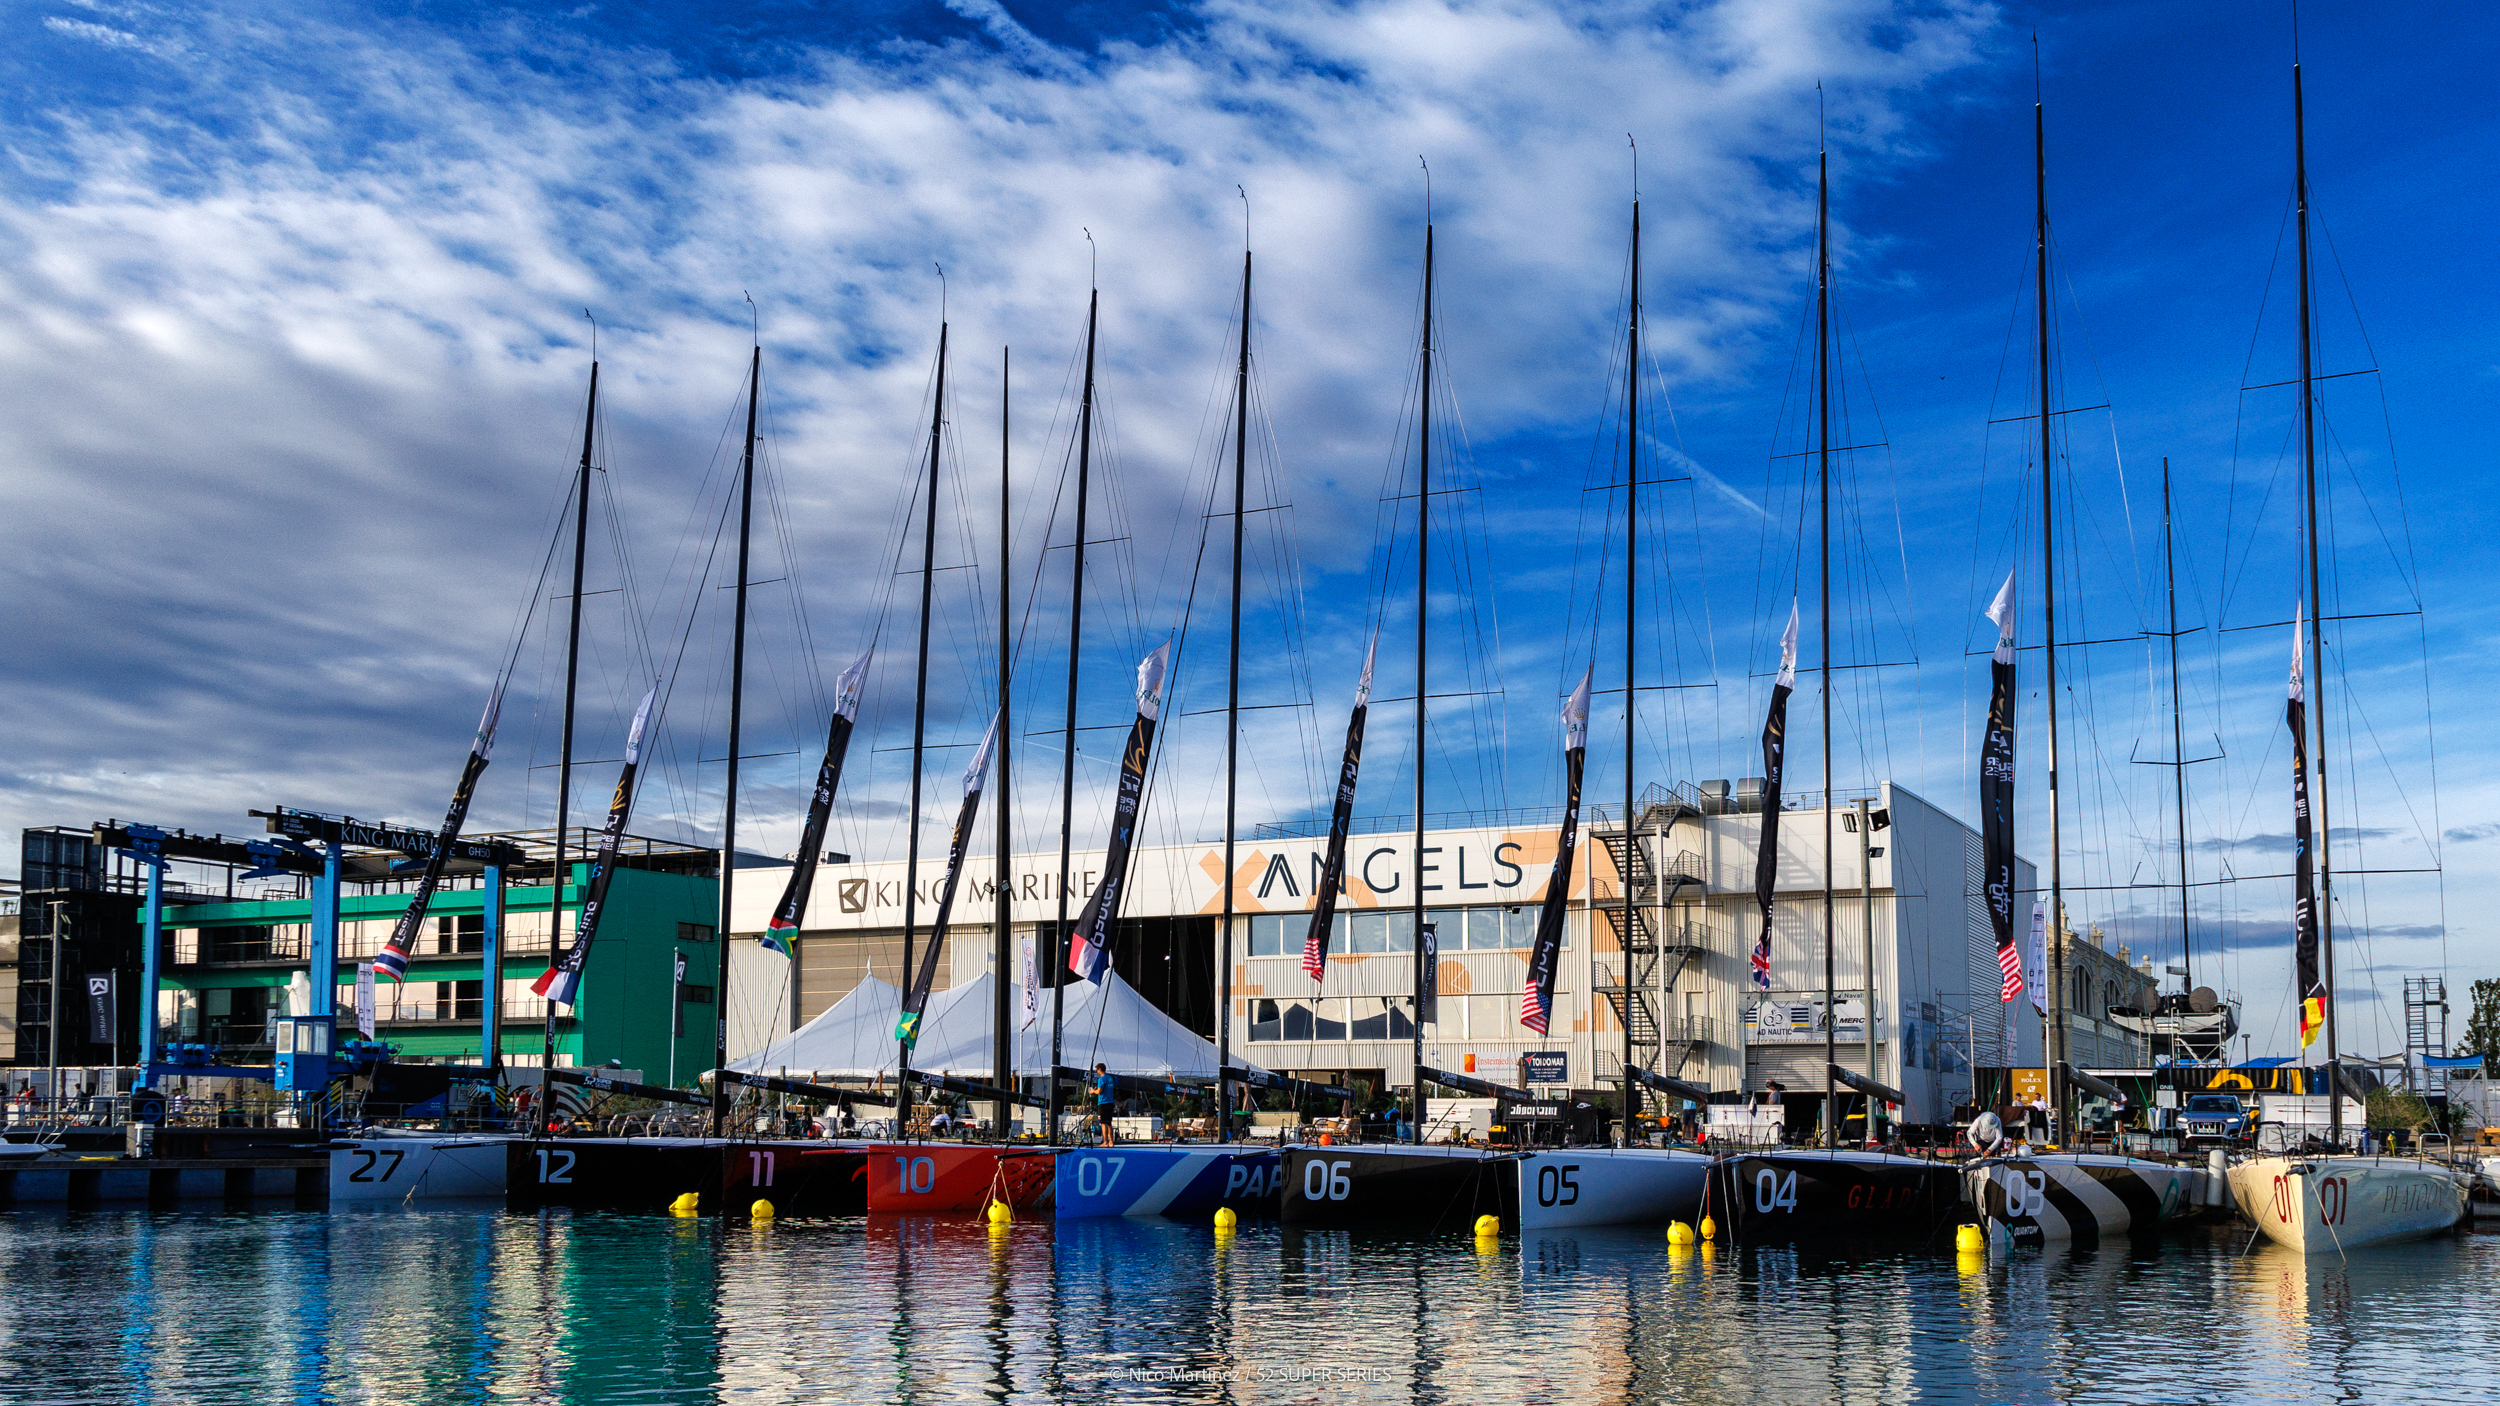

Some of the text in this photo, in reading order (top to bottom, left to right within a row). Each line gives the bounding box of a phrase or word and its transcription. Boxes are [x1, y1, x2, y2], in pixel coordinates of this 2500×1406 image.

[341, 825, 456, 858] KING MARIE
[469, 846, 491, 859] GH50
[1257, 842, 1523, 898] ANGELS
[876, 880, 947, 908] KING
[1757, 1028, 1792, 1036] AD NAUTIC
[1478, 1056, 1509, 1066] Insteimed
[349, 1150, 405, 1182] 27
[536, 1150, 576, 1183] 12
[750, 1151, 775, 1187] 11
[896, 1156, 934, 1193] 10
[1077, 1156, 1126, 1197] 07
[1304, 1159, 1351, 1200] 06
[1538, 1165, 1580, 1208] 05
[1756, 1168, 1797, 1214] 04
[2006, 1169, 2045, 1217] 03
[2274, 1174, 2293, 1224] 01
[2321, 1176, 2348, 1226] 01
[2013, 1225, 2039, 1237] QUANTUM
